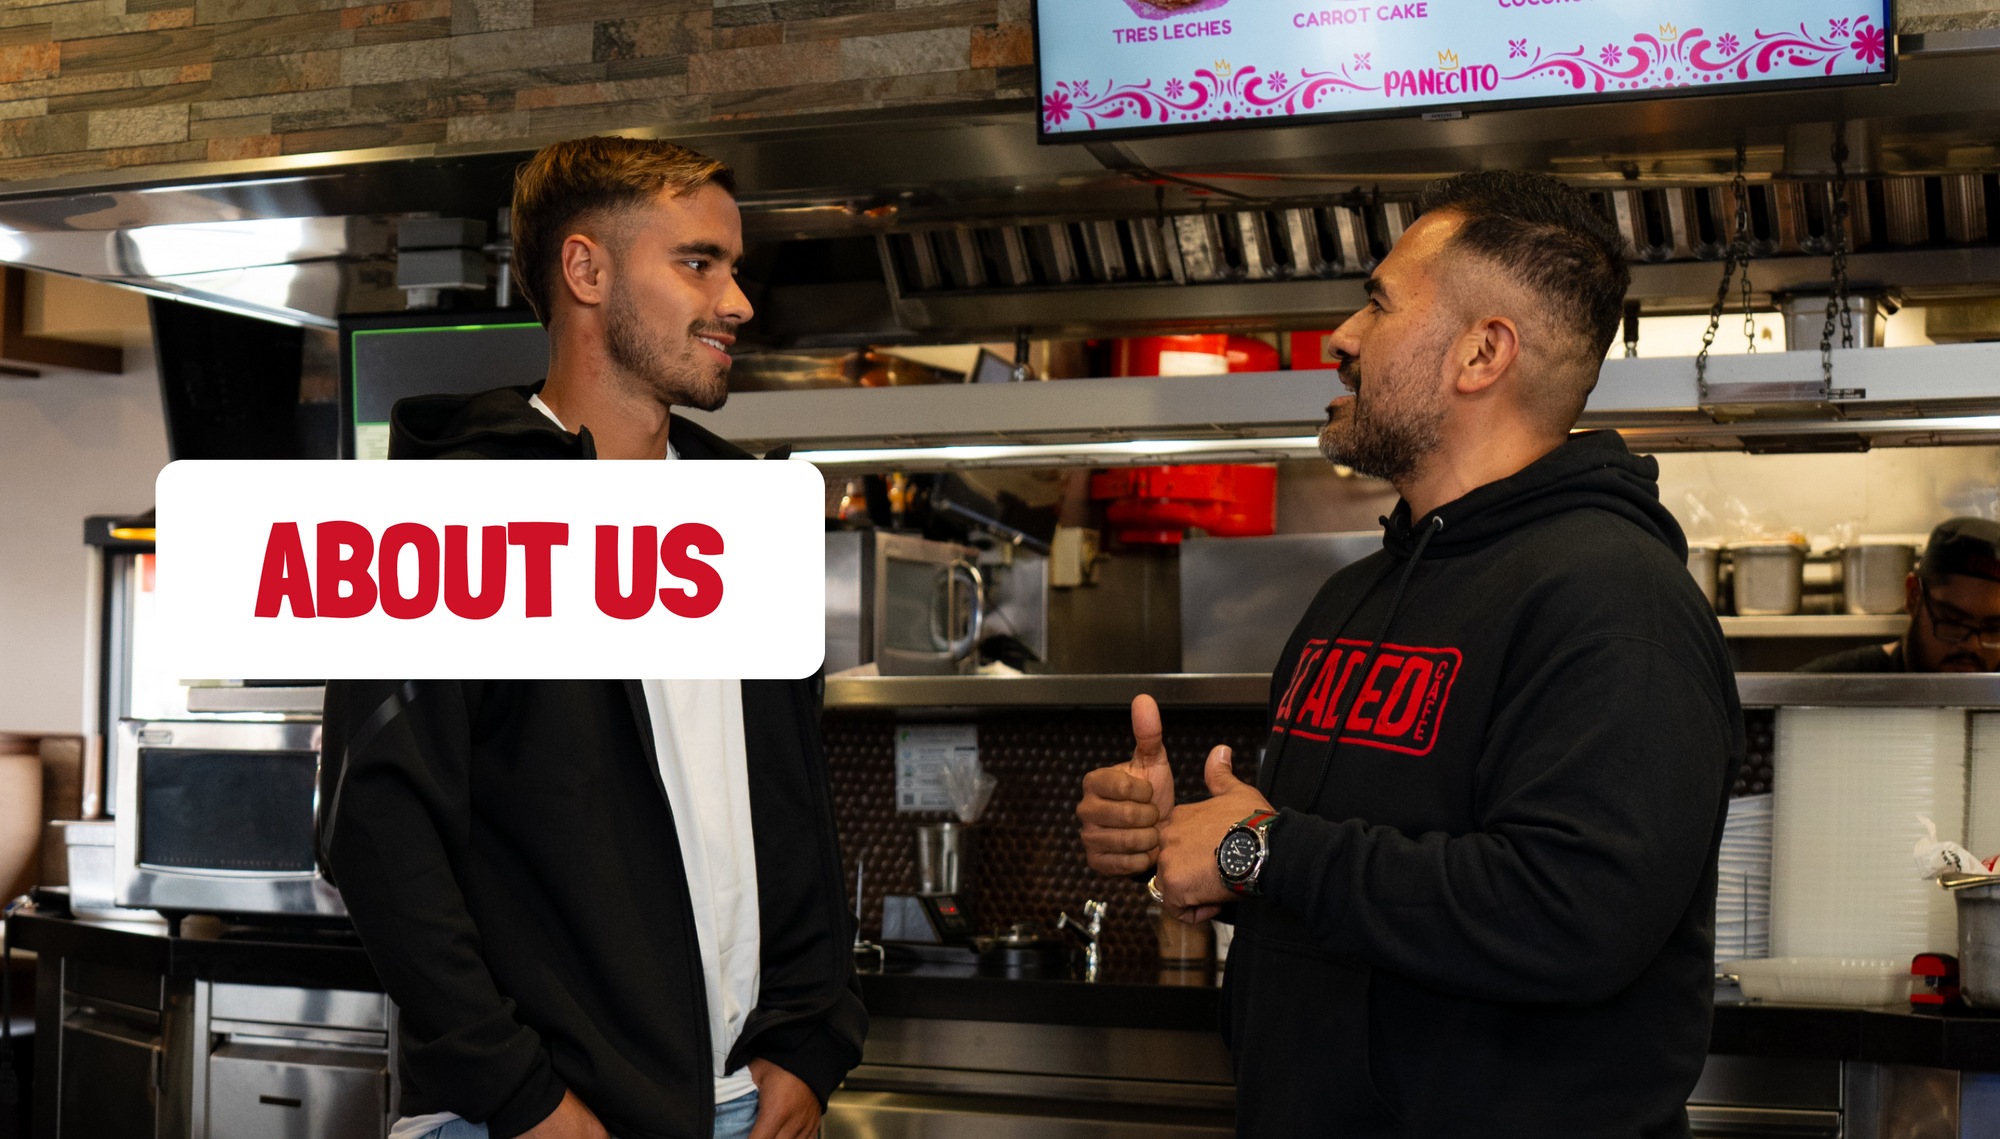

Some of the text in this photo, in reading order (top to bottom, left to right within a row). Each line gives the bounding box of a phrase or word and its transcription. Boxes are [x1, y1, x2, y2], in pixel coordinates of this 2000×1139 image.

[1293, 2, 1428, 28] CARROT CAKE
[1113, 20, 1233, 44] TRES LECHES
[1384, 65, 1499, 97] PANECITO
[1413, 661, 1448, 741] CAFE
